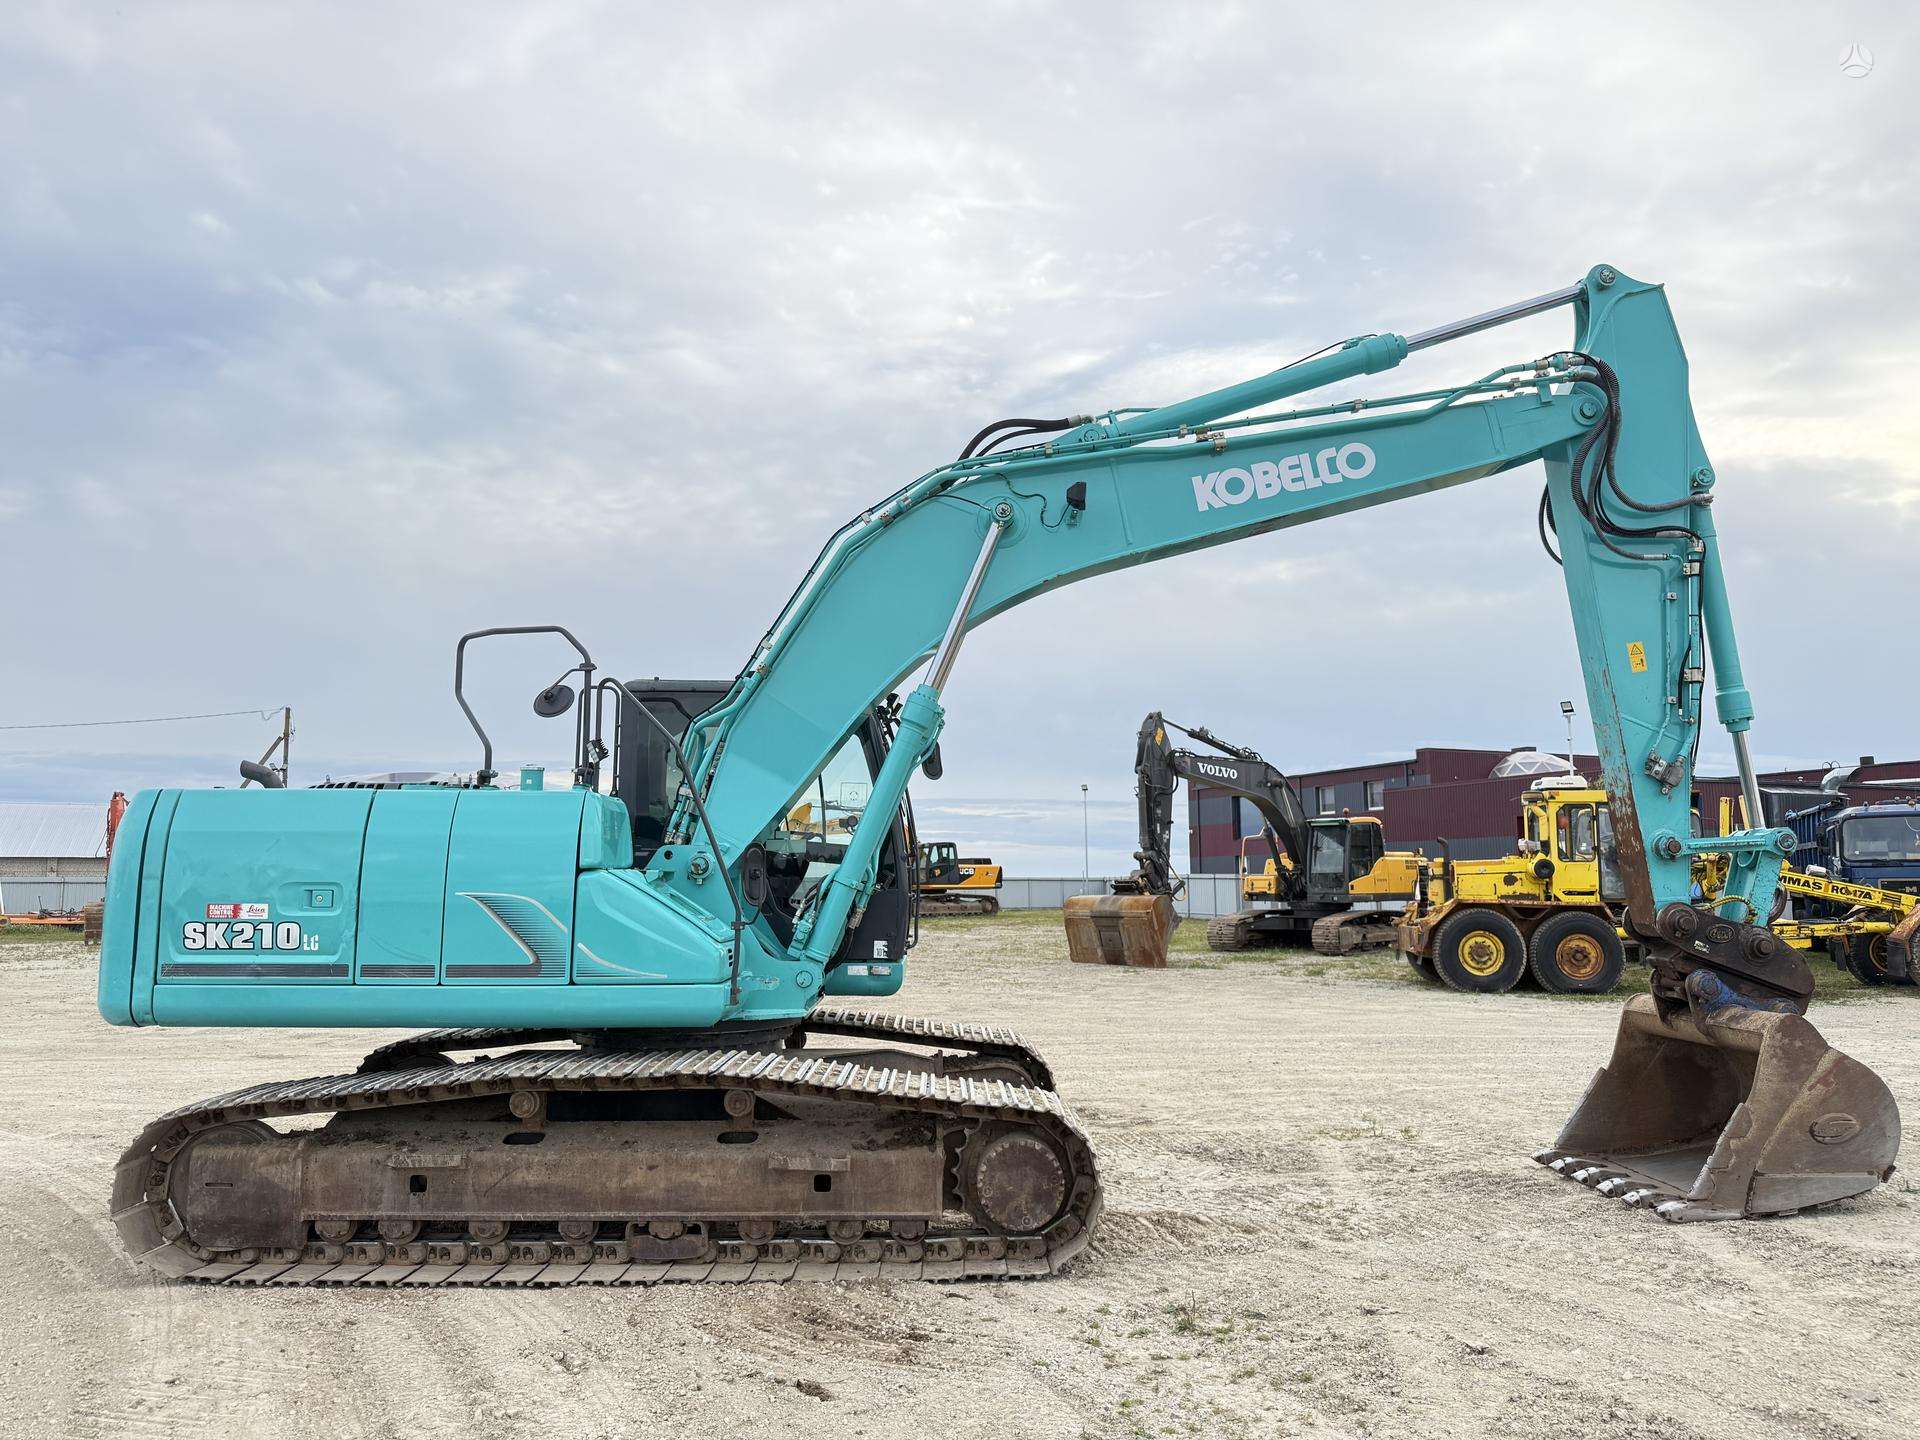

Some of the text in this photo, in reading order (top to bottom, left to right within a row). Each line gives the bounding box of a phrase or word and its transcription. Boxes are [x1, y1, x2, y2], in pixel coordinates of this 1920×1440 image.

[1191, 442, 1377, 512] KOBELCO
[1197, 762, 1238, 779] VOLVO
[183, 921, 301, 950] SK210
[303, 934, 319, 951] LC
